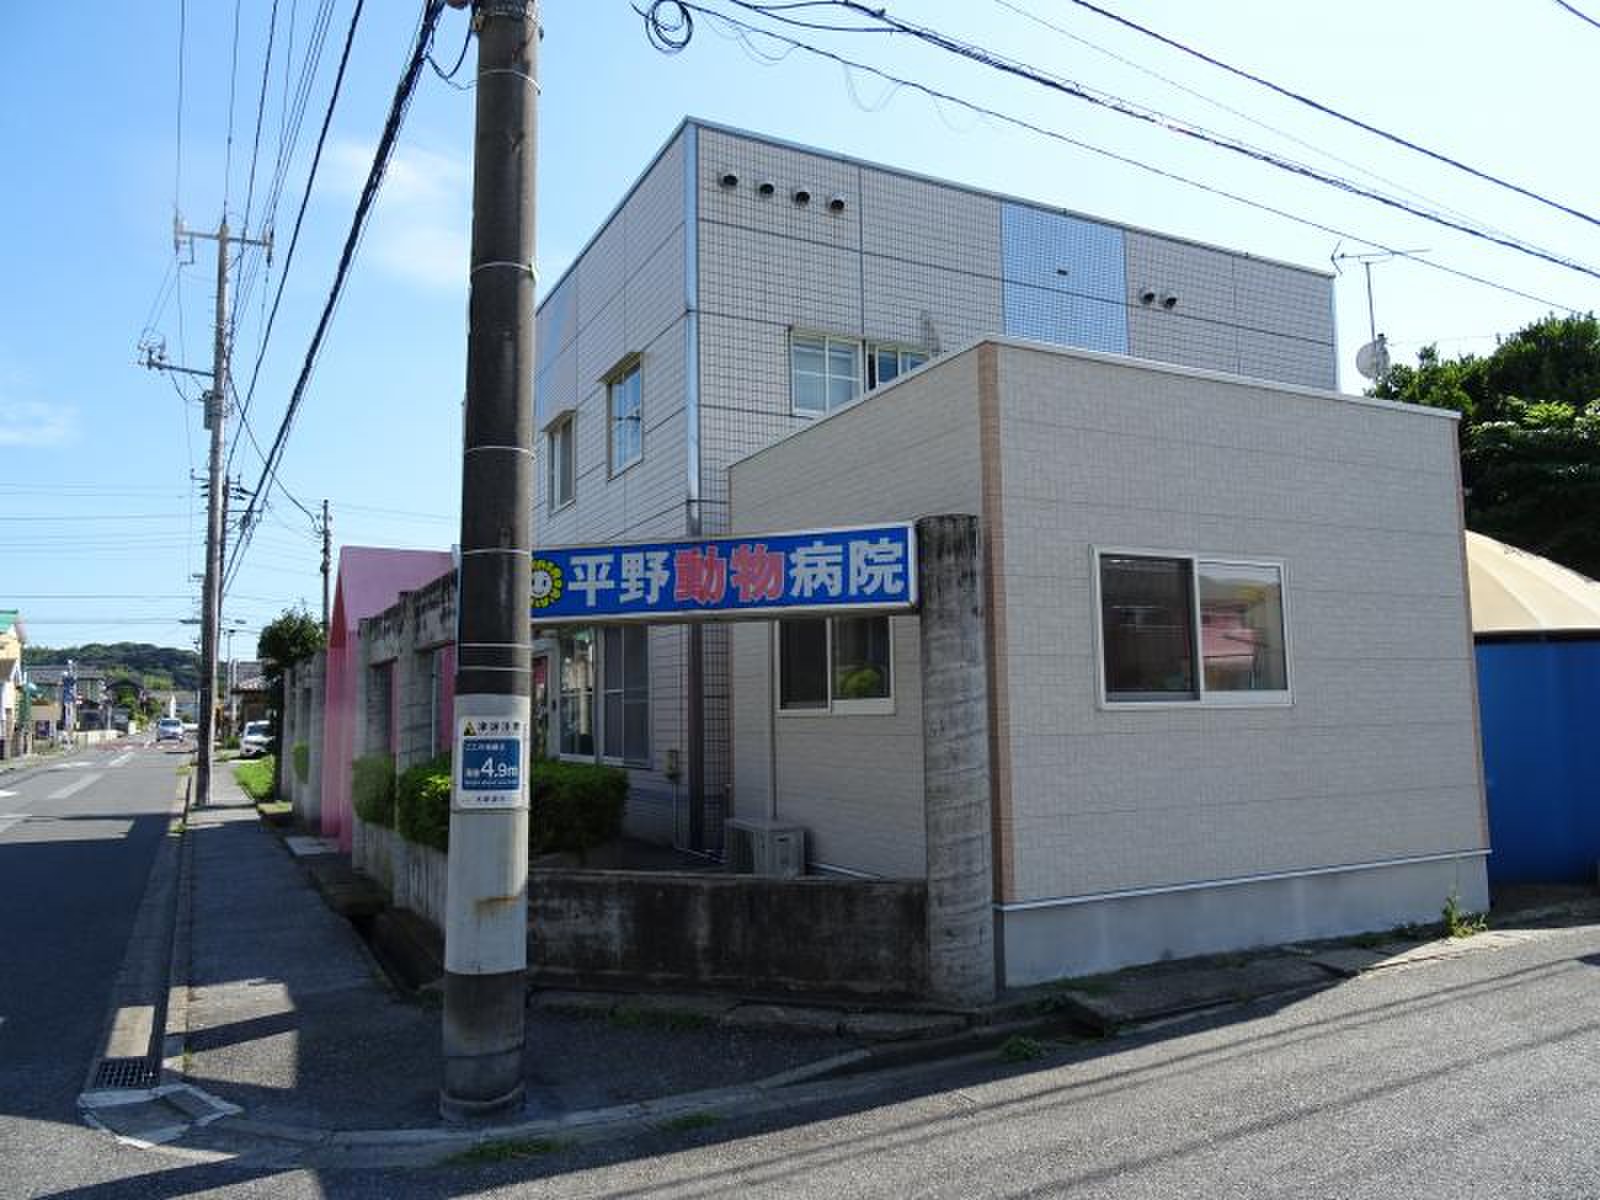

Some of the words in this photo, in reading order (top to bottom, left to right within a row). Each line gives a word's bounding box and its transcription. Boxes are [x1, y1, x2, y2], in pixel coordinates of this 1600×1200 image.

[567, 539, 905, 607] 平野動物病院
